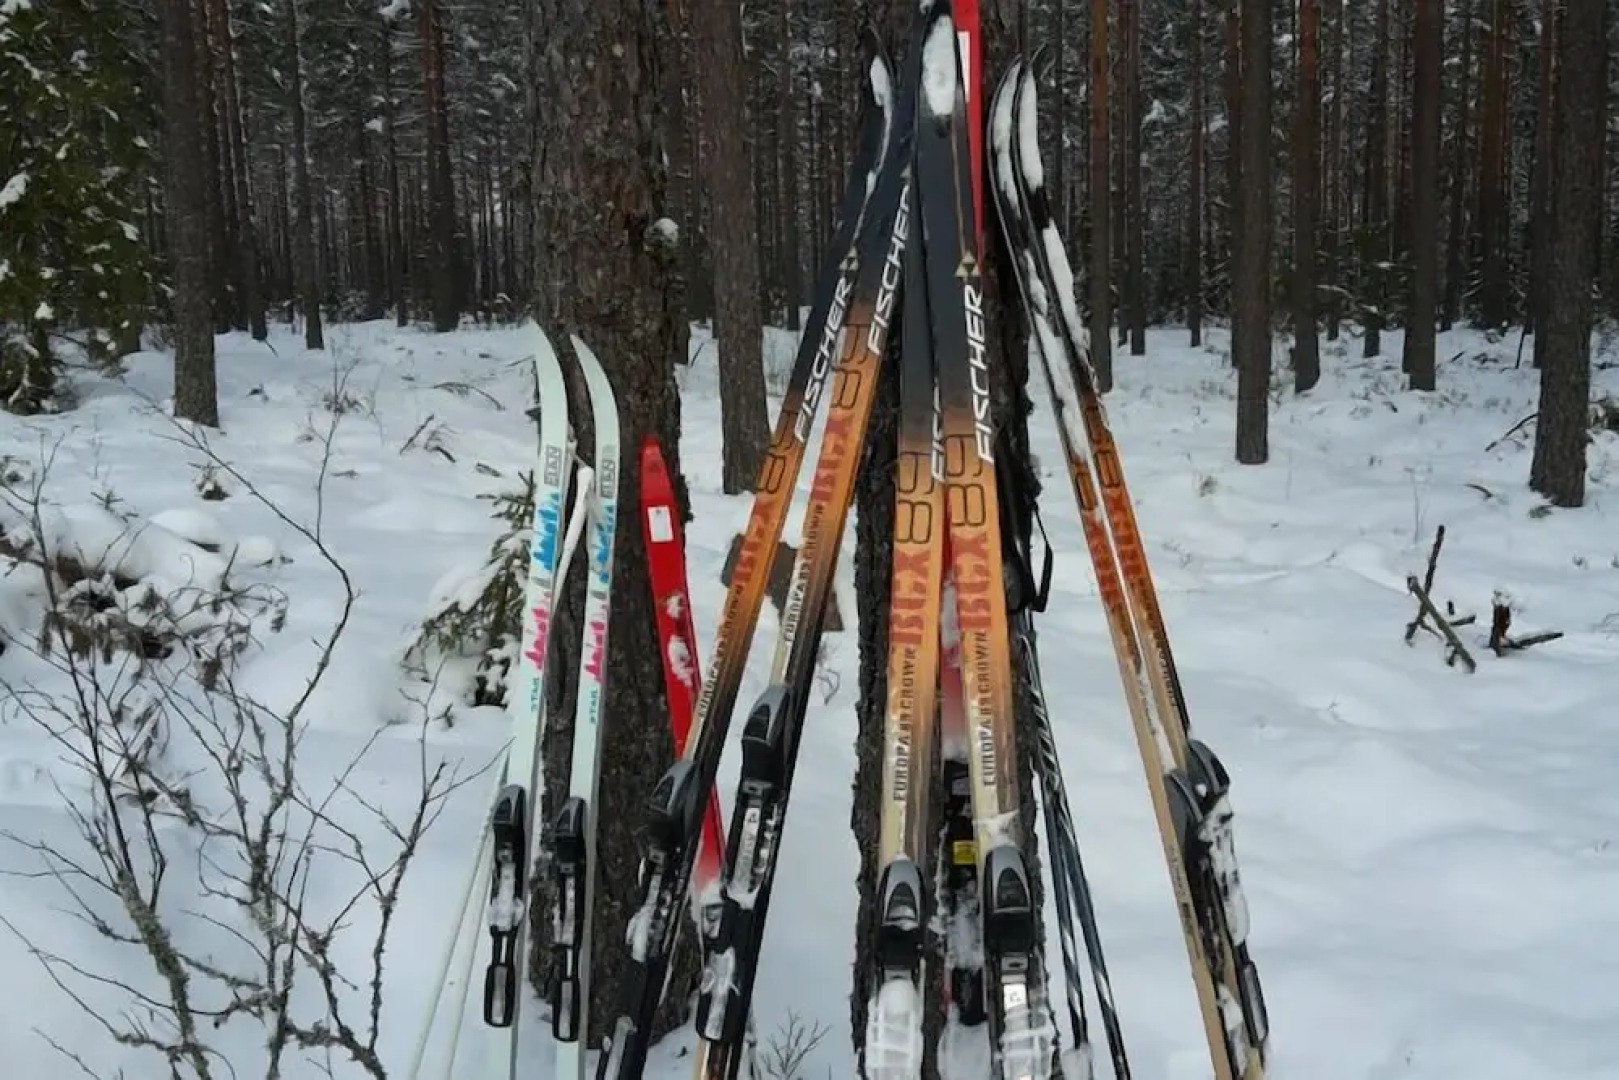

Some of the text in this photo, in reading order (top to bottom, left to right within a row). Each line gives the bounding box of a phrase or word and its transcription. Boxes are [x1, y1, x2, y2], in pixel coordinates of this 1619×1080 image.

[795, 276, 852, 443] FISCHER
[964, 285, 994, 463] FISCHER
[891, 452, 935, 644] BCX 89
[945, 434, 991, 628] BCX 89
[900, 647, 915, 709] CROWN
[975, 632, 990, 694] CROWN
[894, 734, 910, 800] EUROPA
[978, 719, 996, 786] EUROPA
